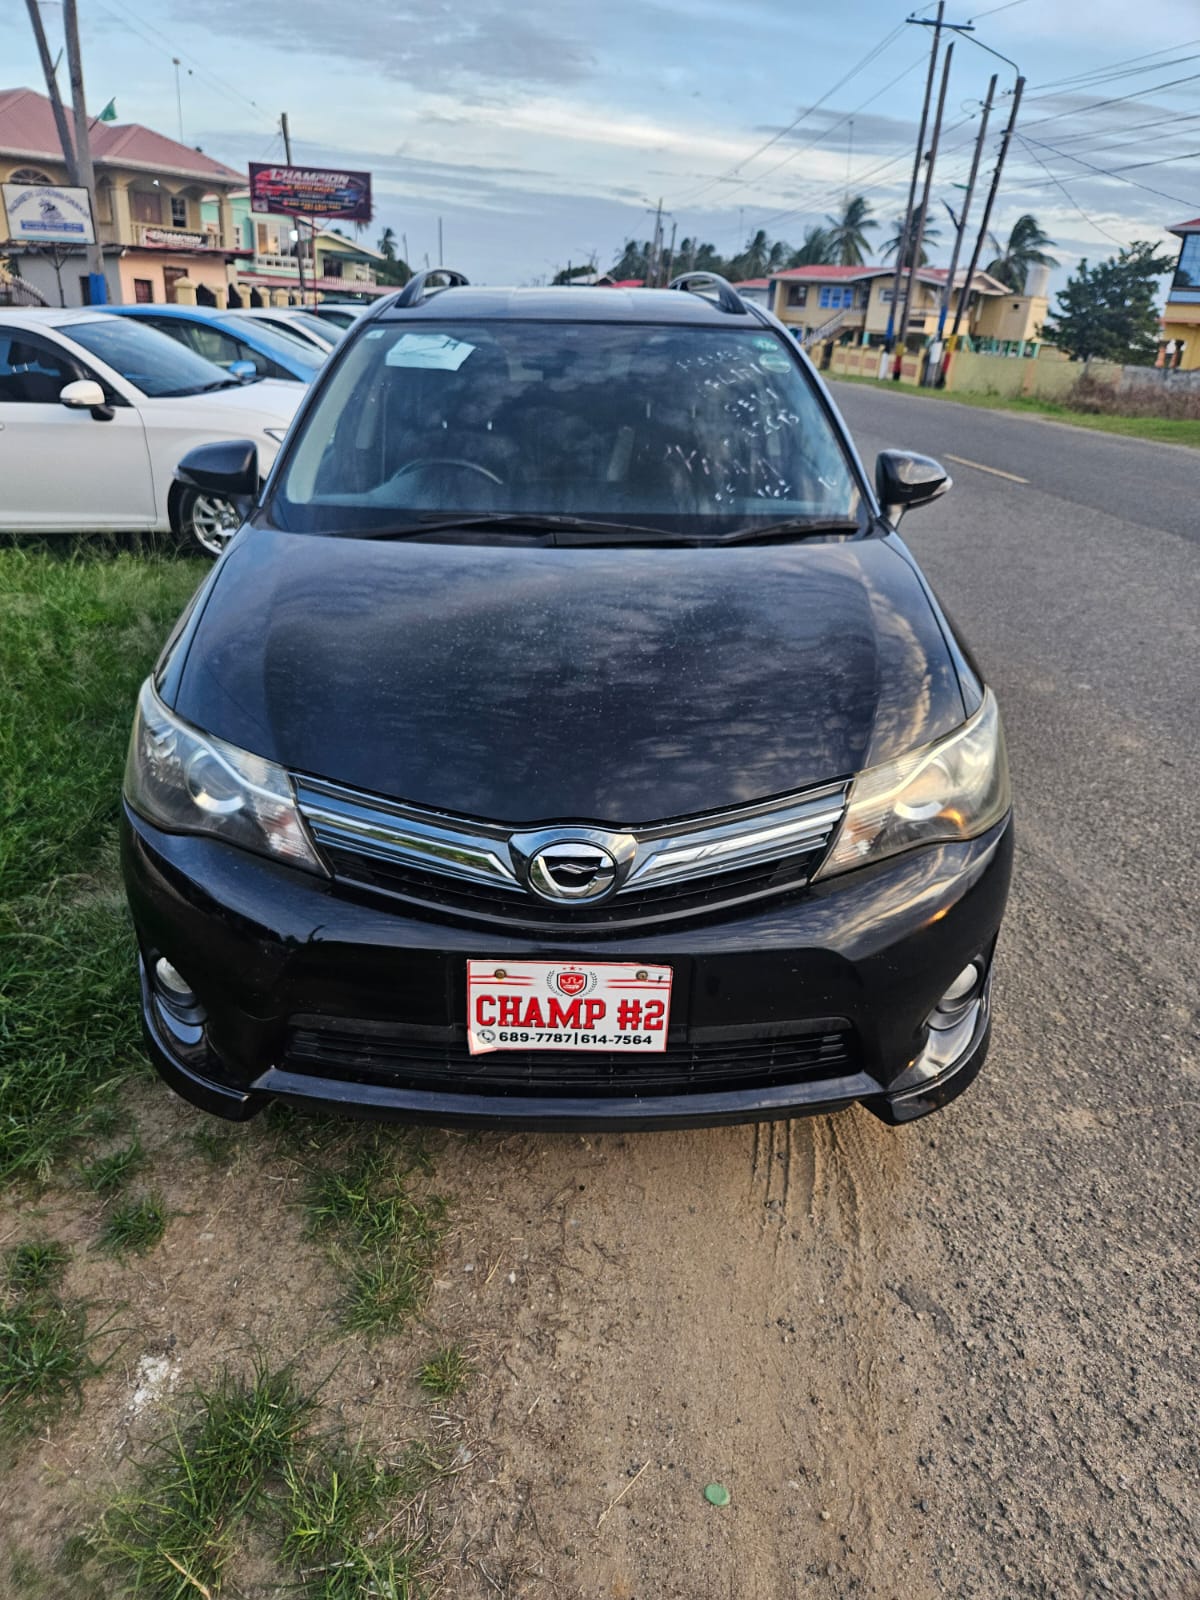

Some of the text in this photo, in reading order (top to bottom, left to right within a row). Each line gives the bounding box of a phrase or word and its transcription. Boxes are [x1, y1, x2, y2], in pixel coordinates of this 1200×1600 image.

[271, 168, 350, 184] CHAMPION
[476, 995, 665, 1030] CHAMP #2
